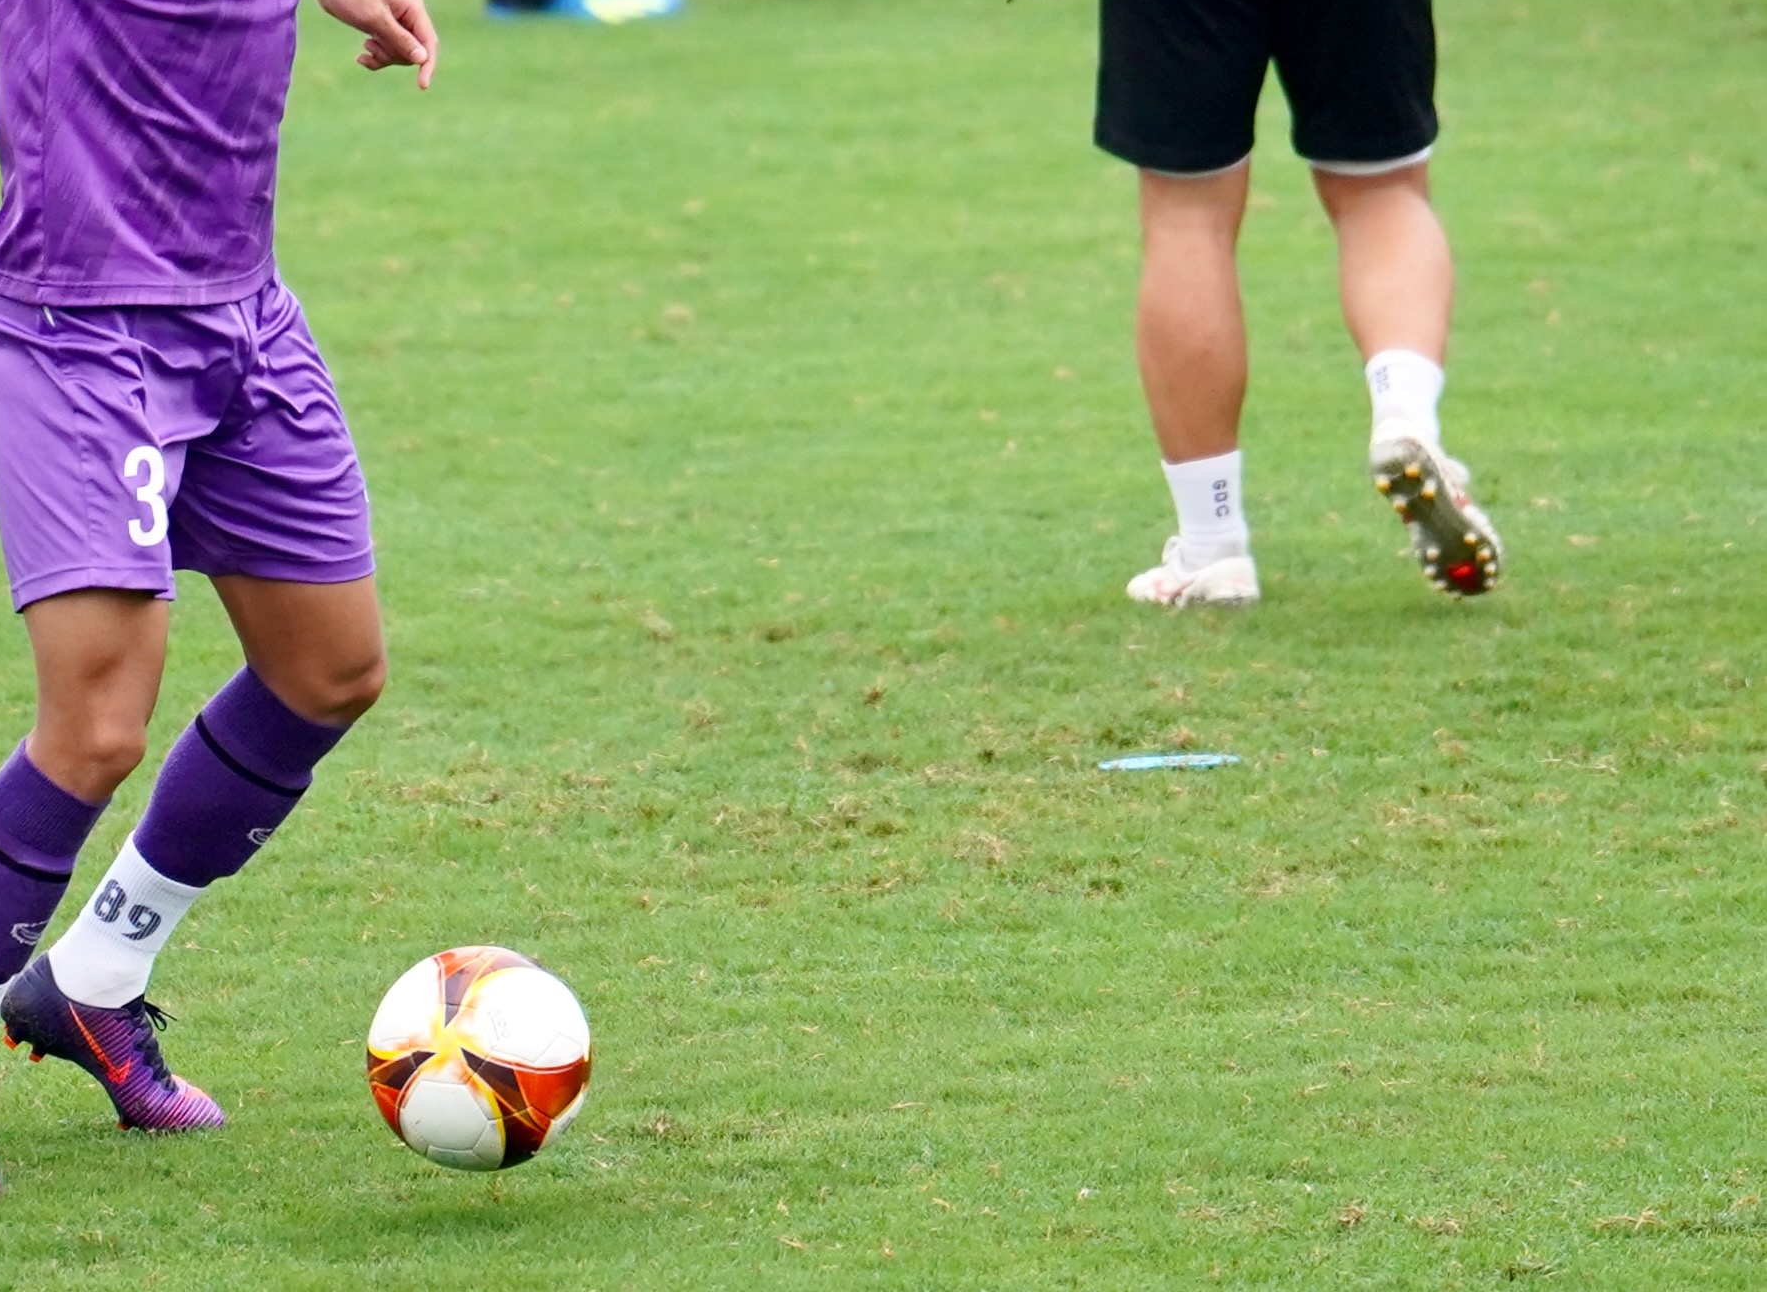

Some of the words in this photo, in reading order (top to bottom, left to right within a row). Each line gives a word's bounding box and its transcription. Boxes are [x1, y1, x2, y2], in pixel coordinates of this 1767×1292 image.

[124, 445, 169, 547] 3
[1212, 479, 1230, 518] GDC
[93, 878, 162, 941] 89
